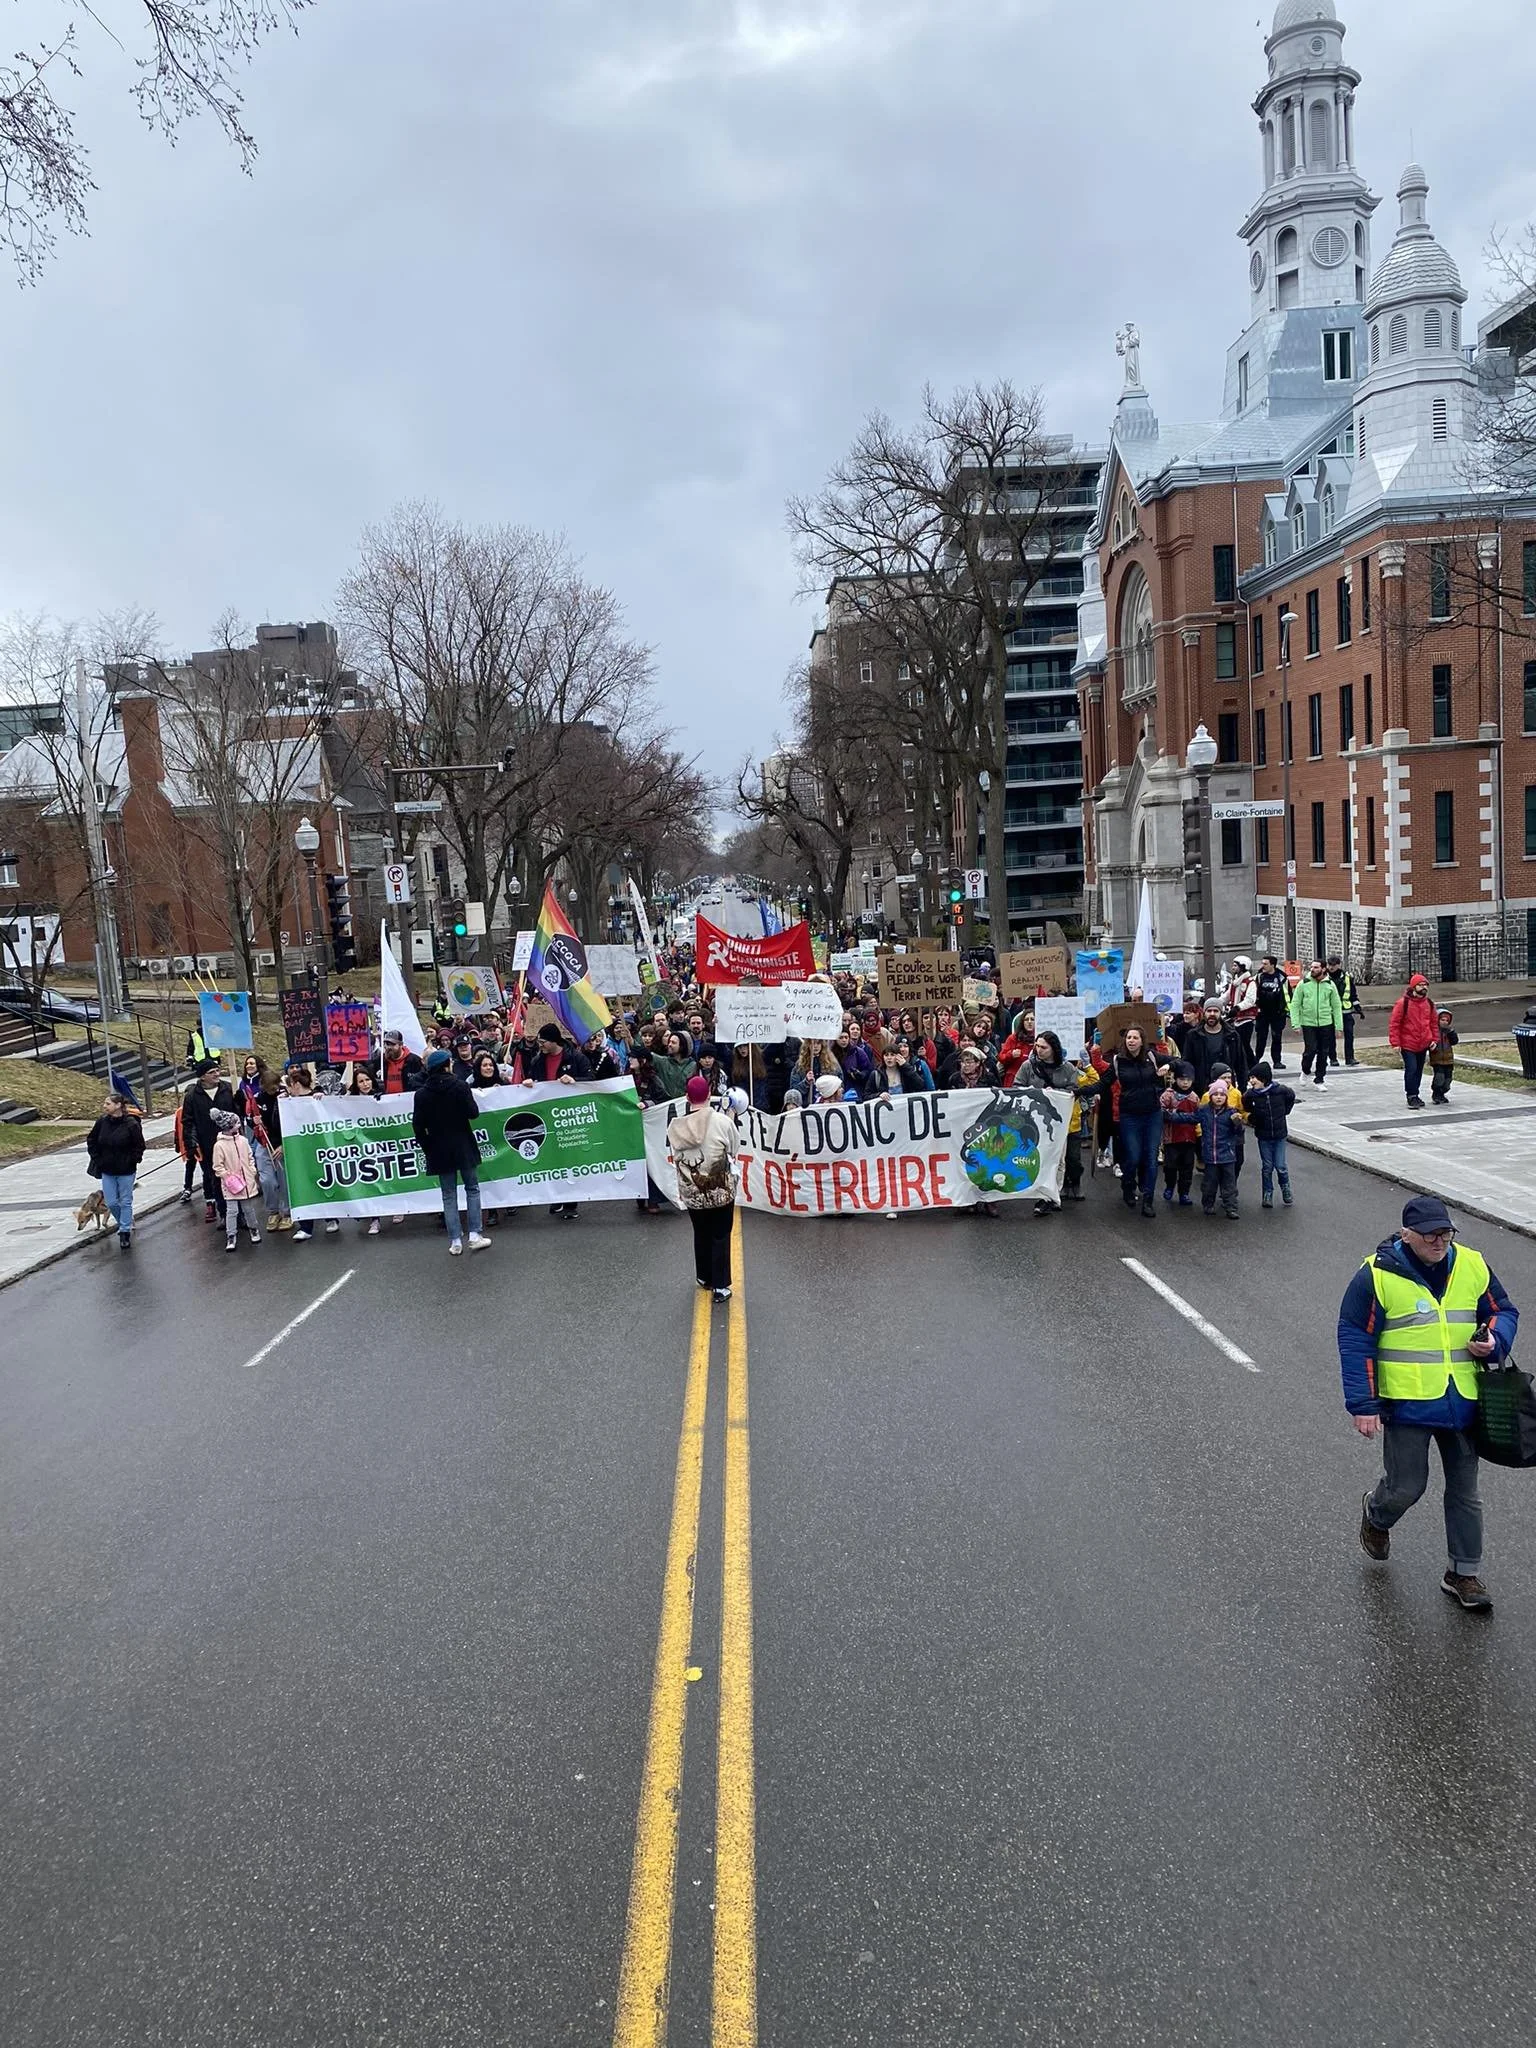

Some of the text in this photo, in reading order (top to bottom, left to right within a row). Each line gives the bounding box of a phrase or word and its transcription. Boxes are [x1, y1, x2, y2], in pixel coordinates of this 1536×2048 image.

[1225, 807, 1283, 818] Claire-Fontaine
[862, 913, 873, 922] 50
[726, 938, 762, 955] PARTI
[556, 940, 583, 972] CCQCA
[886, 975, 923, 986] PLEURS
[923, 974, 935, 983] DE
[551, 1101, 598, 1118] Conseil
[300, 1119, 353, 1135] JUSTICE
[553, 1112, 600, 1128] central
[800, 1100, 896, 1156] DONC
[908, 1092, 951, 1141] DE
[317, 1146, 360, 1161] POUR
[365, 1141, 396, 1155] UNE
[318, 1153, 418, 1188] JUSTE
[517, 1160, 627, 1185] JUSTICE SOCIALE
[764, 1152, 953, 1212] DÉTRUIRE
